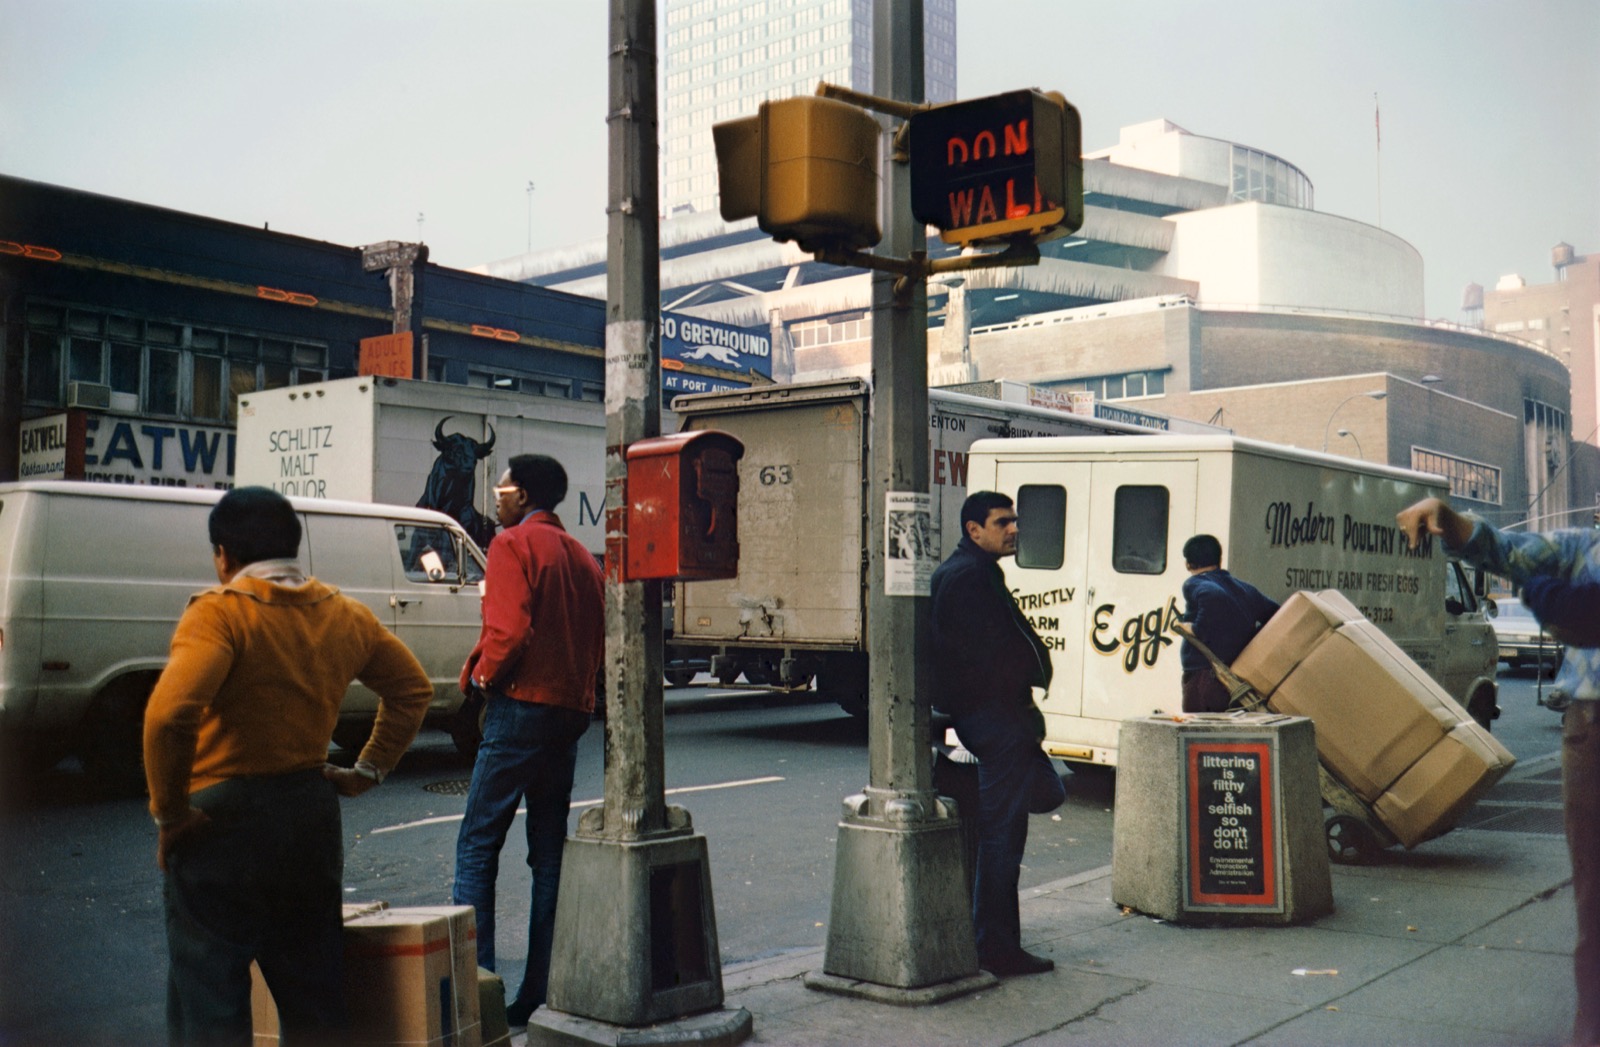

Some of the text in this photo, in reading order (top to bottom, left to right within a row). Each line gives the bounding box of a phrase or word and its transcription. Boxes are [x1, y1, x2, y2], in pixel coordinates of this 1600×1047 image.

[368, 336, 405, 359] ADULT
[680, 321, 769, 357] GREYHOUND
[364, 360, 406, 377] MOIES
[666, 376, 739, 393] AT PORT AUT
[929, 415, 966, 432] ENTON
[22, 424, 65, 454] EATWELL
[269, 425, 333, 453] SCHLITZ
[21, 458, 65, 477] Restaurant
[280, 453, 319, 478] MALT
[929, 444, 969, 488] EW
[759, 464, 794, 486] 63
[1265, 501, 1335, 548] Modern
[1343, 514, 1396, 555] POULTRY
[1286, 567, 1420, 595] STRICTLY FARM FRESH EGGS
[1011, 587, 1076, 611] STRICTLY
[1028, 616, 1059, 631] ARM
[1203, 755, 1255, 770] littering
[1222, 768, 1234, 779] is
[1212, 779, 1245, 793] filthy
[1224, 792, 1234, 803] &
[1208, 803, 1252, 815] selfish
[1221, 816, 1238, 826] so
[1213, 826, 1248, 838] don't
[1213, 838, 1248, 850] do it!
